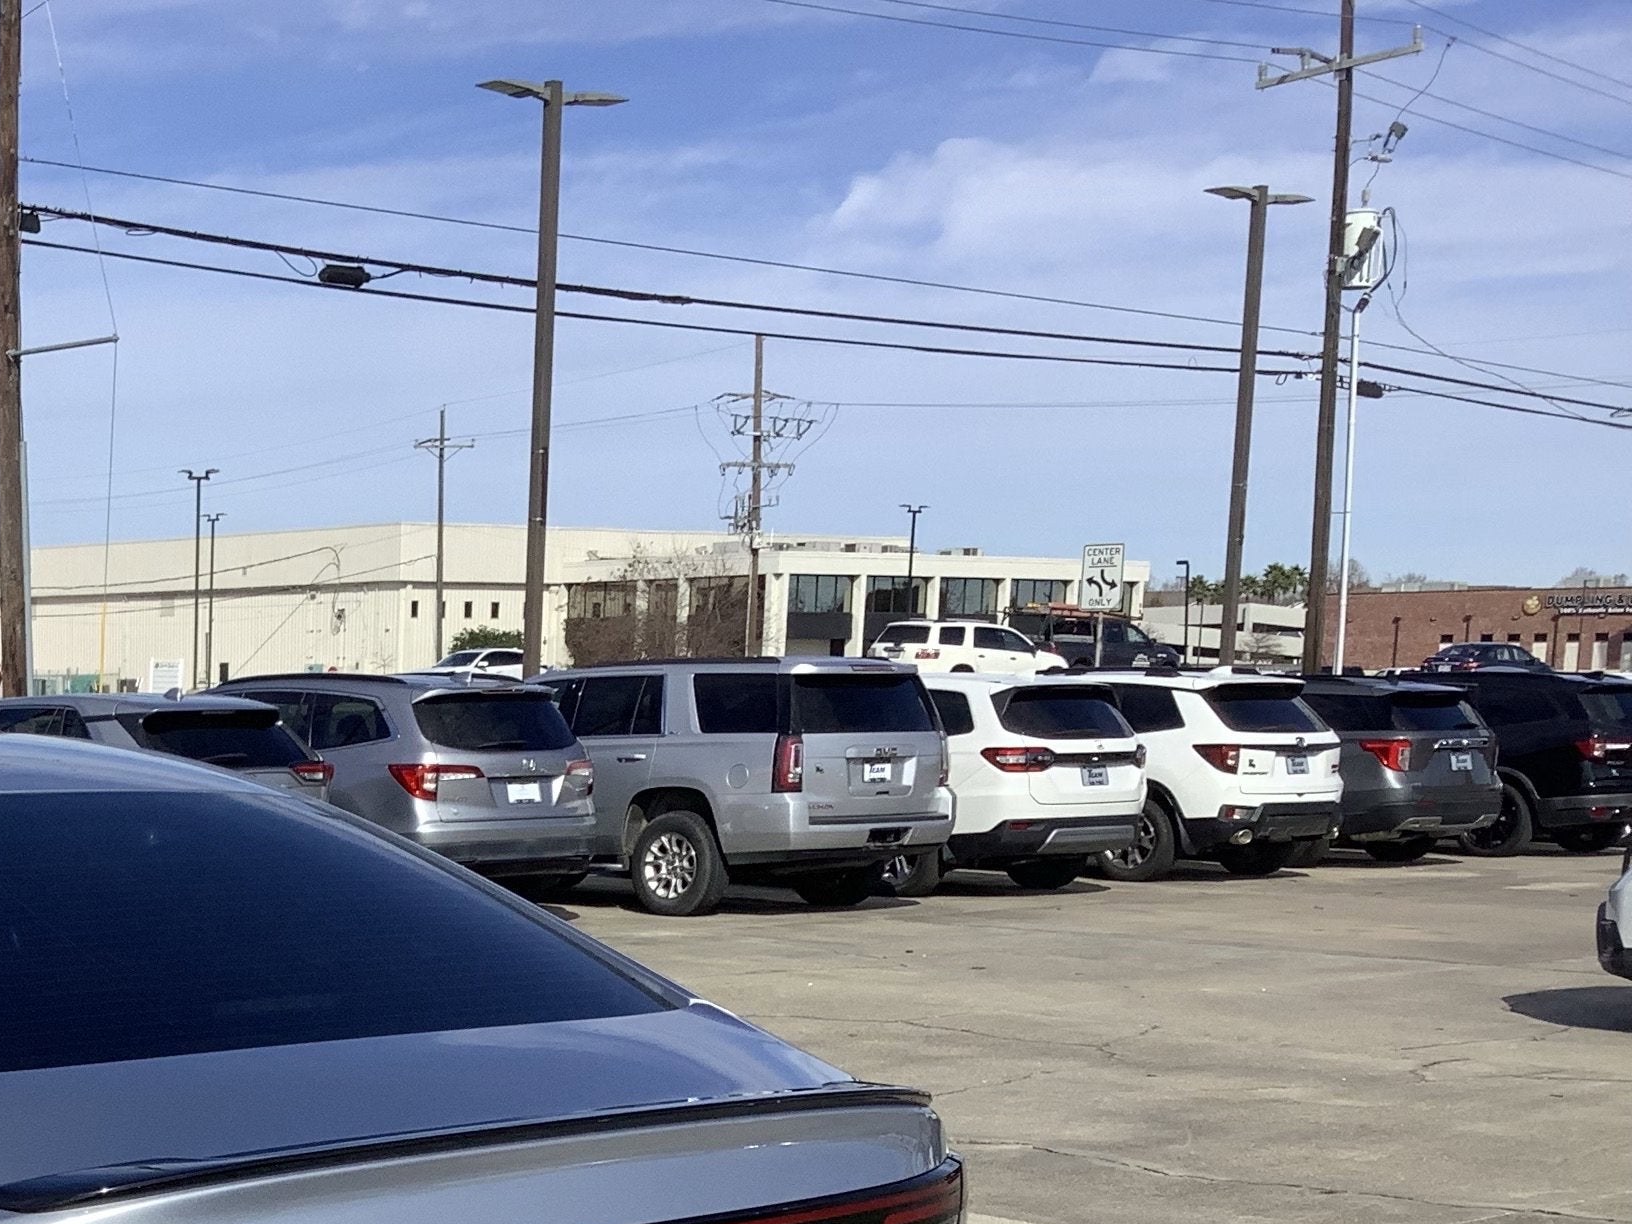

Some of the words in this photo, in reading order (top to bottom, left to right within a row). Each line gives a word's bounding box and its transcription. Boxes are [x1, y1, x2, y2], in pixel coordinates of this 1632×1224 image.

[1087, 547, 1121, 556] CENTER
[1091, 557, 1115, 565] LANE
[1088, 598, 1112, 606] ONLY
[1546, 594, 1612, 607] DUMPLING
